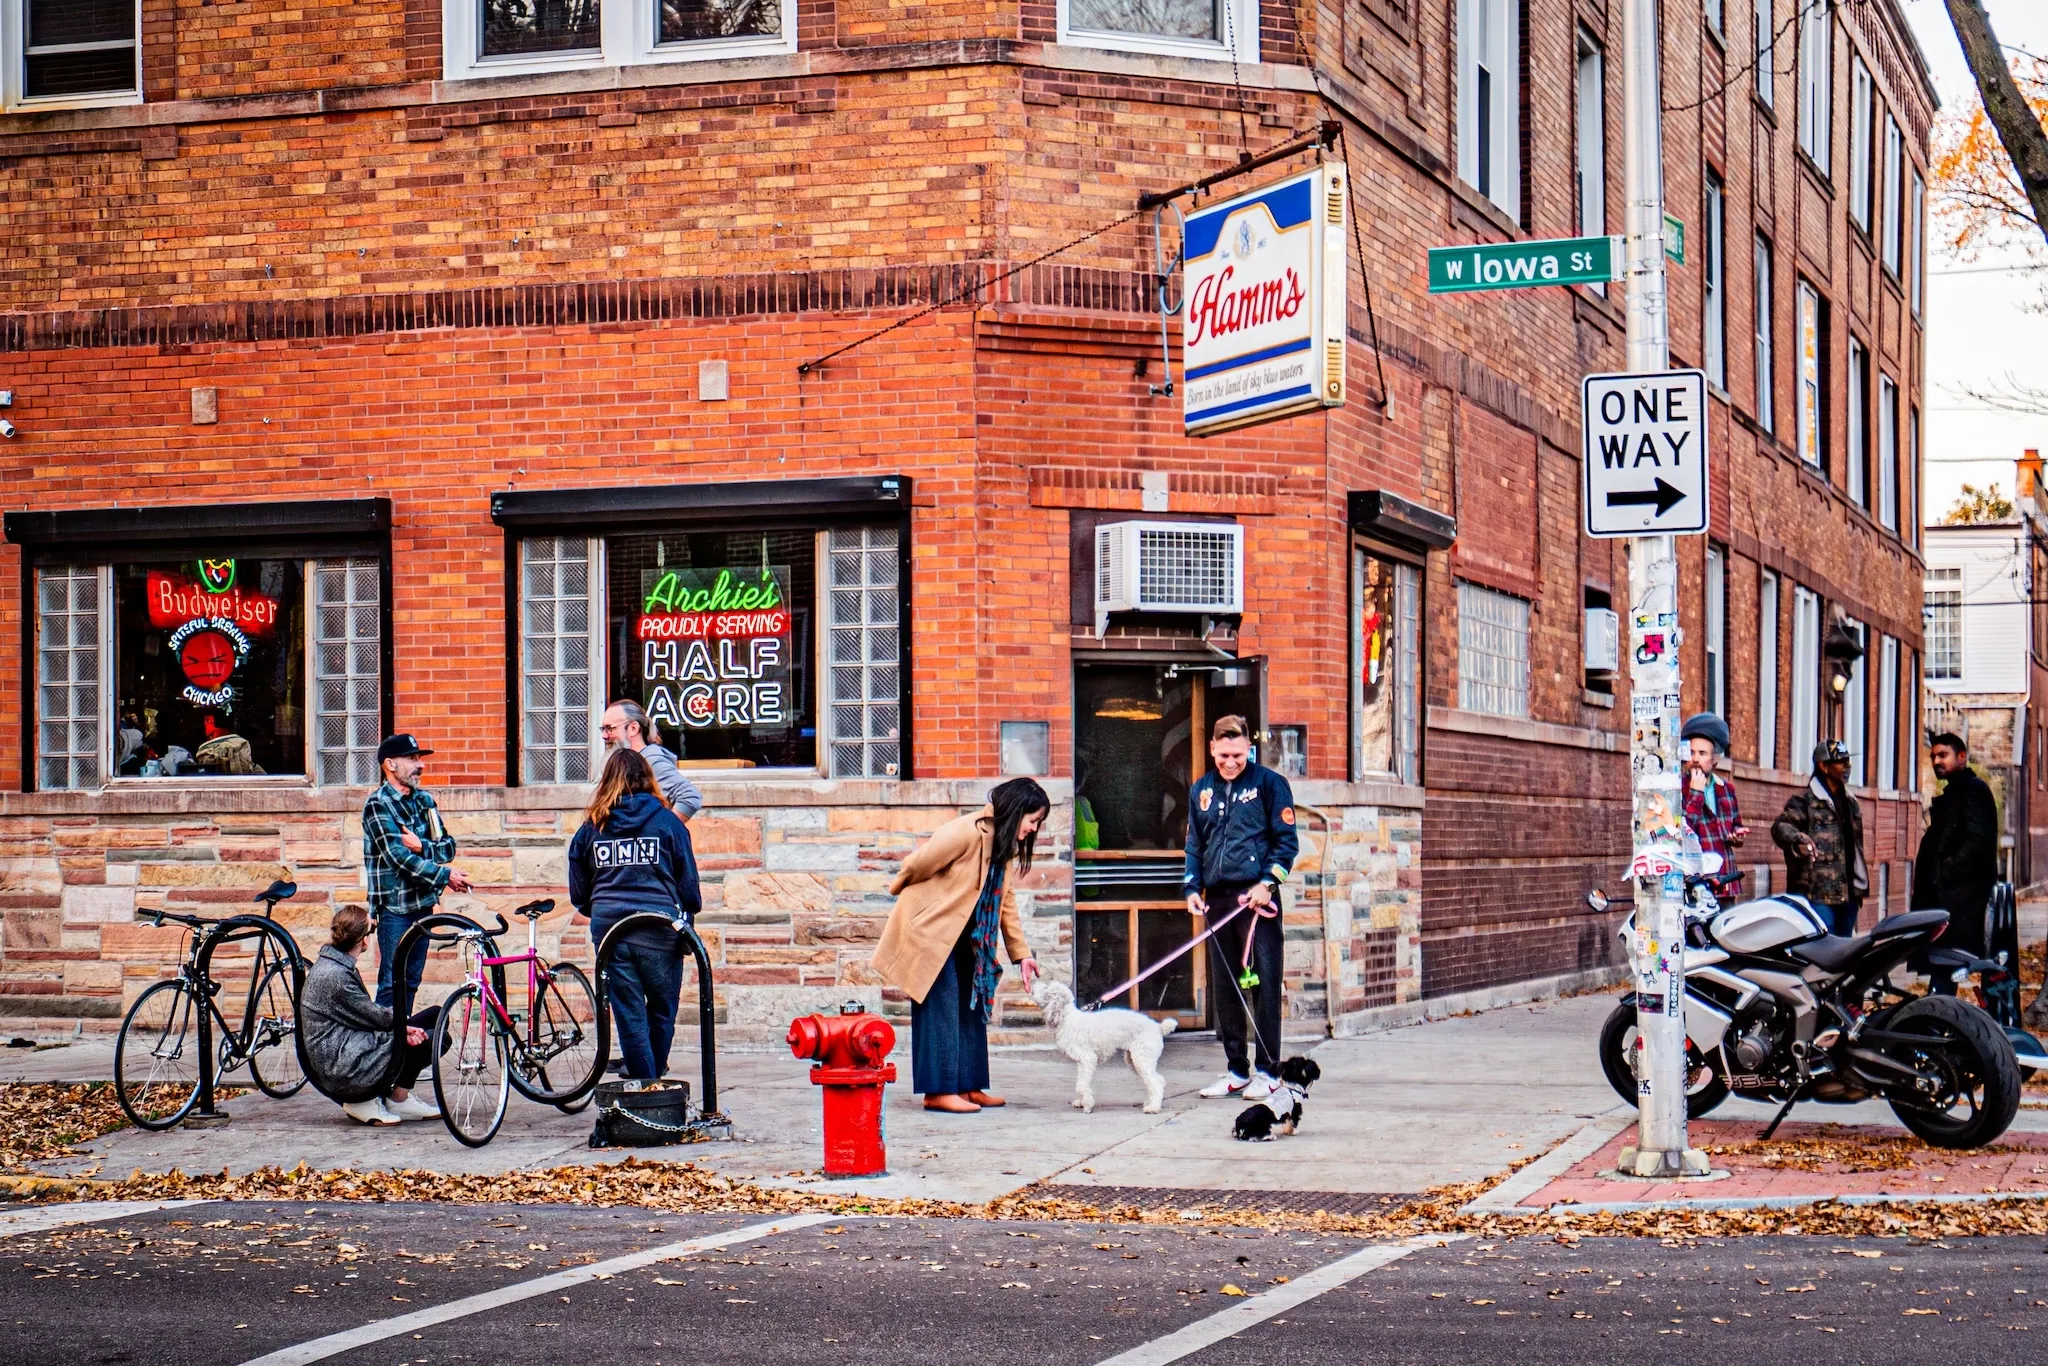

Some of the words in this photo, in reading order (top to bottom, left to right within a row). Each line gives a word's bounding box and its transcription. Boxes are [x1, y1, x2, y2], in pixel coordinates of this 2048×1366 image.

[1446, 260, 1462, 280] W
[1473, 253, 1559, 284] Iowa
[1571, 251, 1593, 272] St
[1187, 265, 1306, 347] Hamm's
[1187, 387, 1204, 405] Born
[1205, 386, 1212, 400] in
[1213, 381, 1224, 398] the
[1225, 375, 1241, 395] land
[1242, 372, 1251, 396] of
[1250, 371, 1262, 392] sky
[1263, 367, 1279, 386] blue
[1279, 363, 1304, 381] waters
[1601, 387, 1689, 425] ONE
[1599, 431, 1691, 469] WAY
[160, 580, 278, 624] Budweiser
[644, 569, 780, 613] Archie's
[168, 617, 208, 651] SPITEFUL
[211, 615, 250, 654] BREWING
[640, 616, 713, 638] PROUDLY
[715, 612, 784, 635] SERVING
[643, 638, 781, 681] HALF
[183, 686, 232, 706] CHICAGO
[645, 683, 783, 727] ACRE
